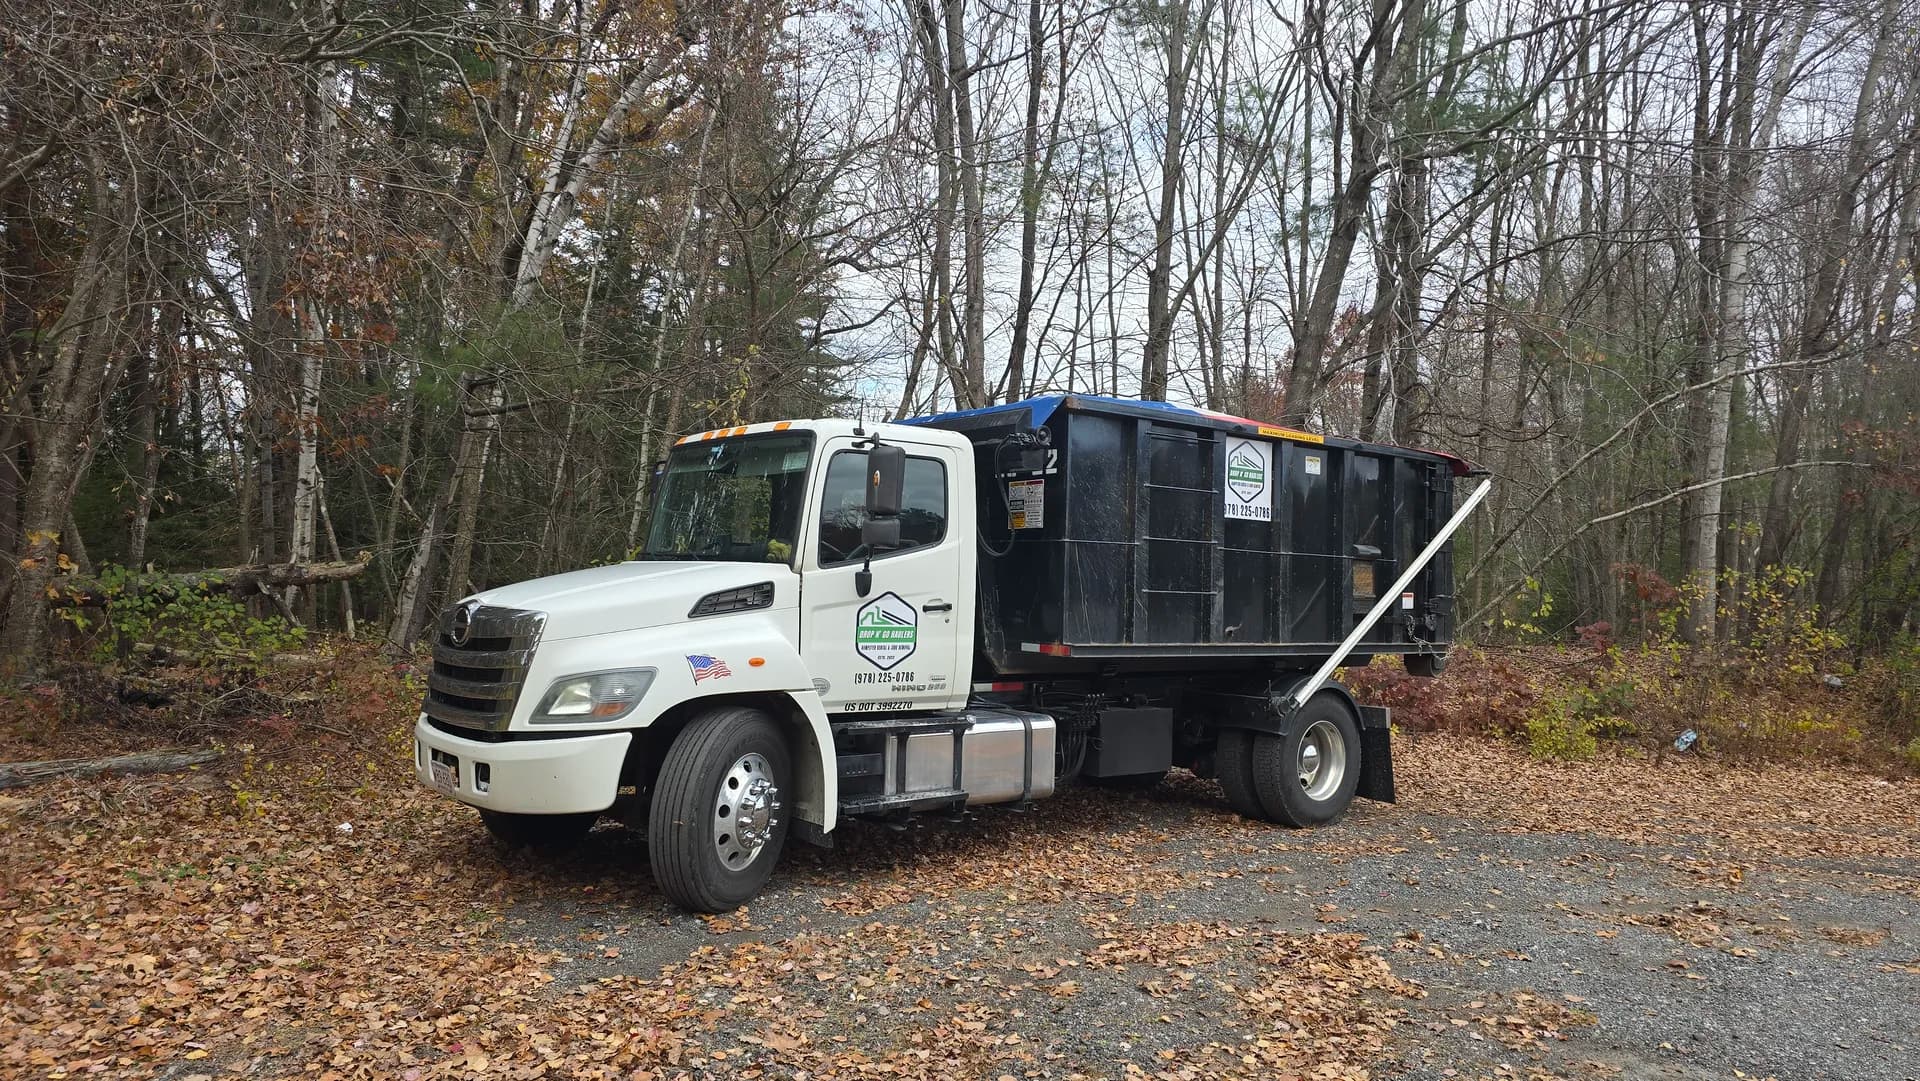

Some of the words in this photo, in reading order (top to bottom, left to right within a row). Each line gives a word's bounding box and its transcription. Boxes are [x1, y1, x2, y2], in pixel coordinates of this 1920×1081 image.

[1240, 505, 1270, 519] 225-0786
[854, 672, 876, 685] (978)
[878, 671, 915, 683] 225-0786
[891, 684, 926, 692] HINO
[844, 702, 856, 711] US
[858, 702, 876, 711] DOT
[876, 701, 913, 710] 3992270
